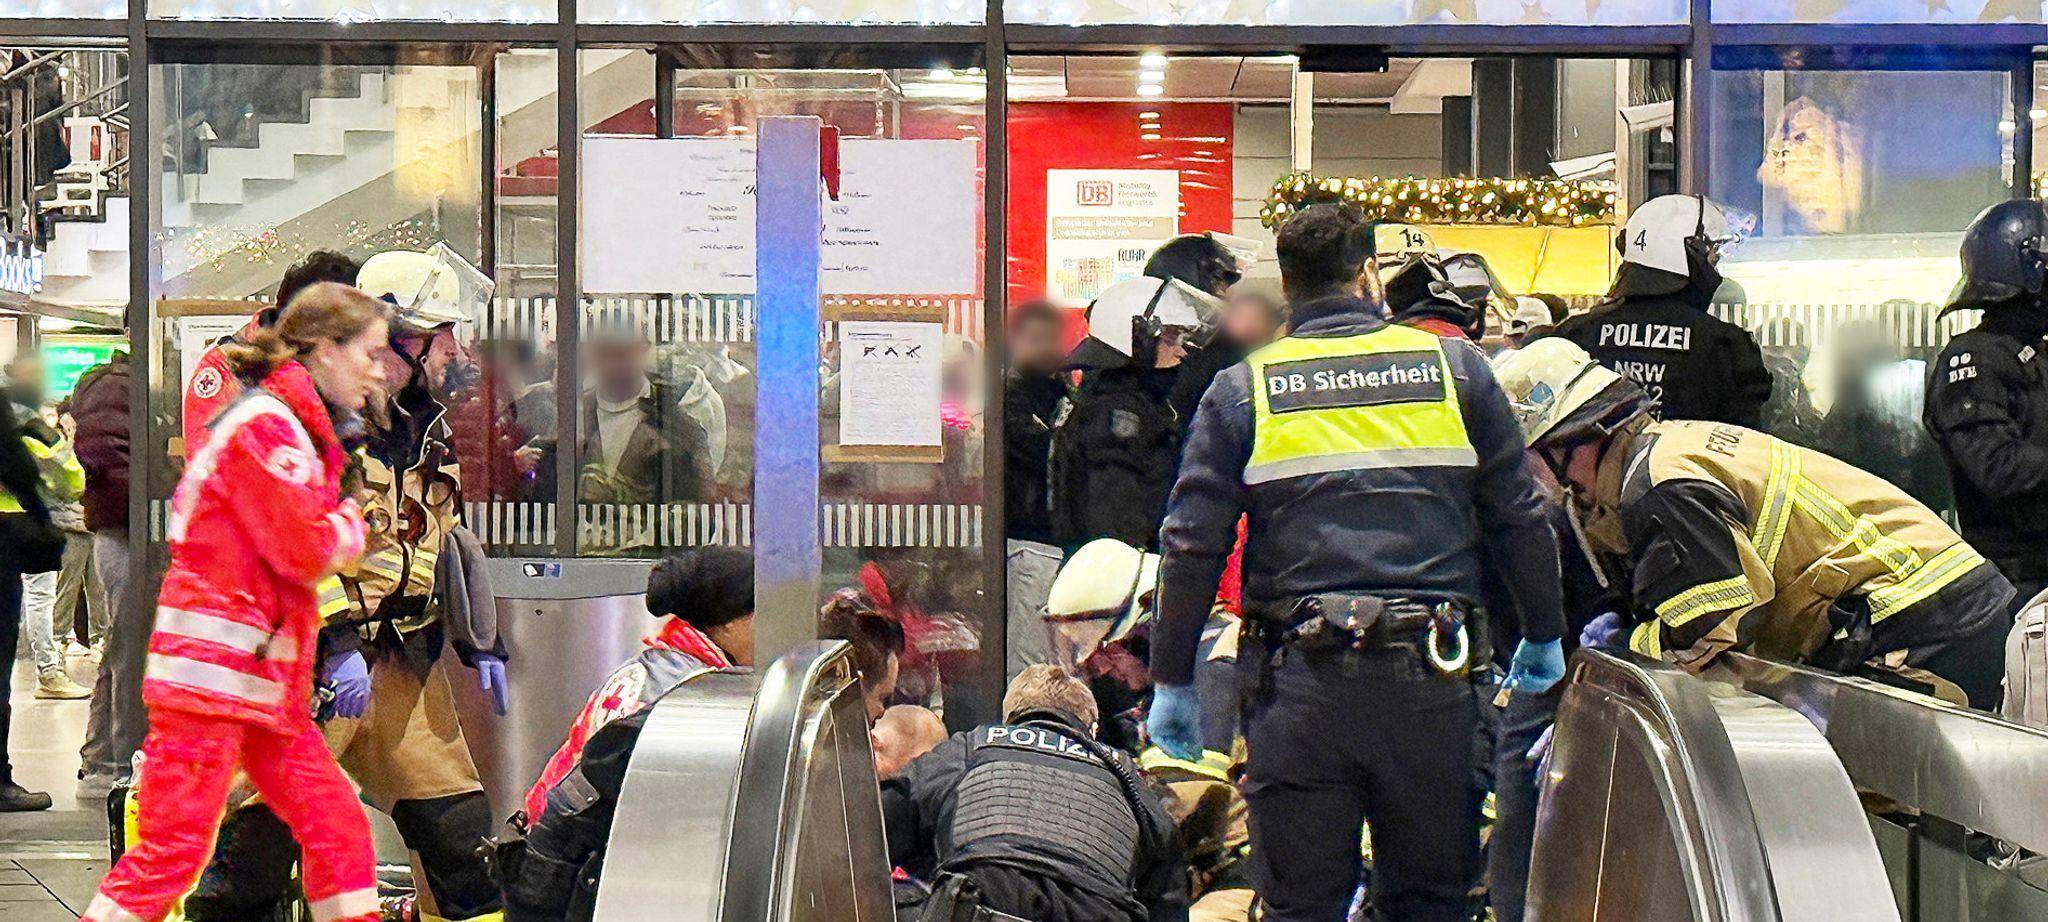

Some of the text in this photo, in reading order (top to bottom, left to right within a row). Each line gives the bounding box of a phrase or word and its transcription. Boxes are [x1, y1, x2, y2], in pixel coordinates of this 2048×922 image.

[1080, 182, 1110, 204] DB
[1399, 228, 1425, 247] 14
[1634, 229, 1647, 251] 4
[1599, 323, 1691, 350] POLIZEI
[1269, 363, 1440, 396] DB Sicherheit
[1615, 360, 1666, 383] NRW
